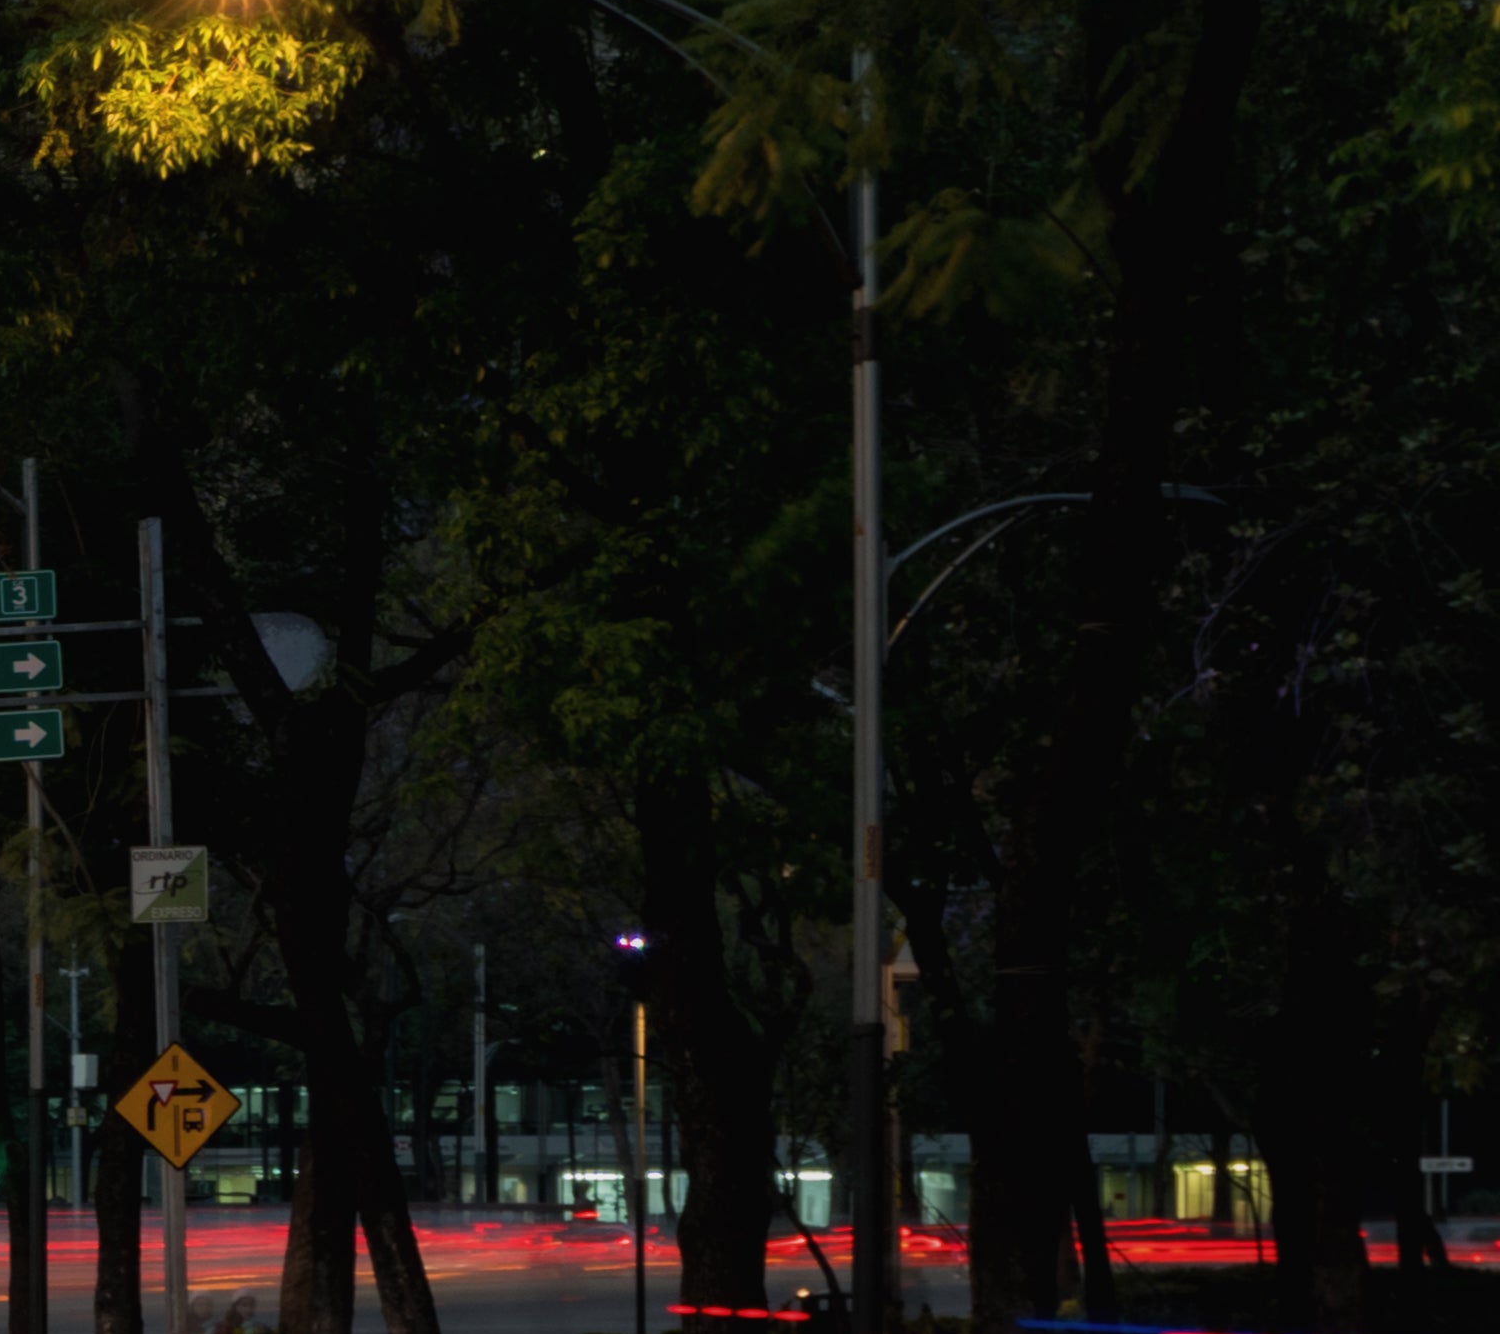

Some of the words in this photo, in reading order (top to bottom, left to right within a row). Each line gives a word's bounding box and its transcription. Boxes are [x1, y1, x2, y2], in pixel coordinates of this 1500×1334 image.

[11, 585, 28, 606] 3
[132, 849, 194, 862] ORDINARIO
[148, 871, 188, 898] rtp
[151, 906, 202, 918] EXPRESO
